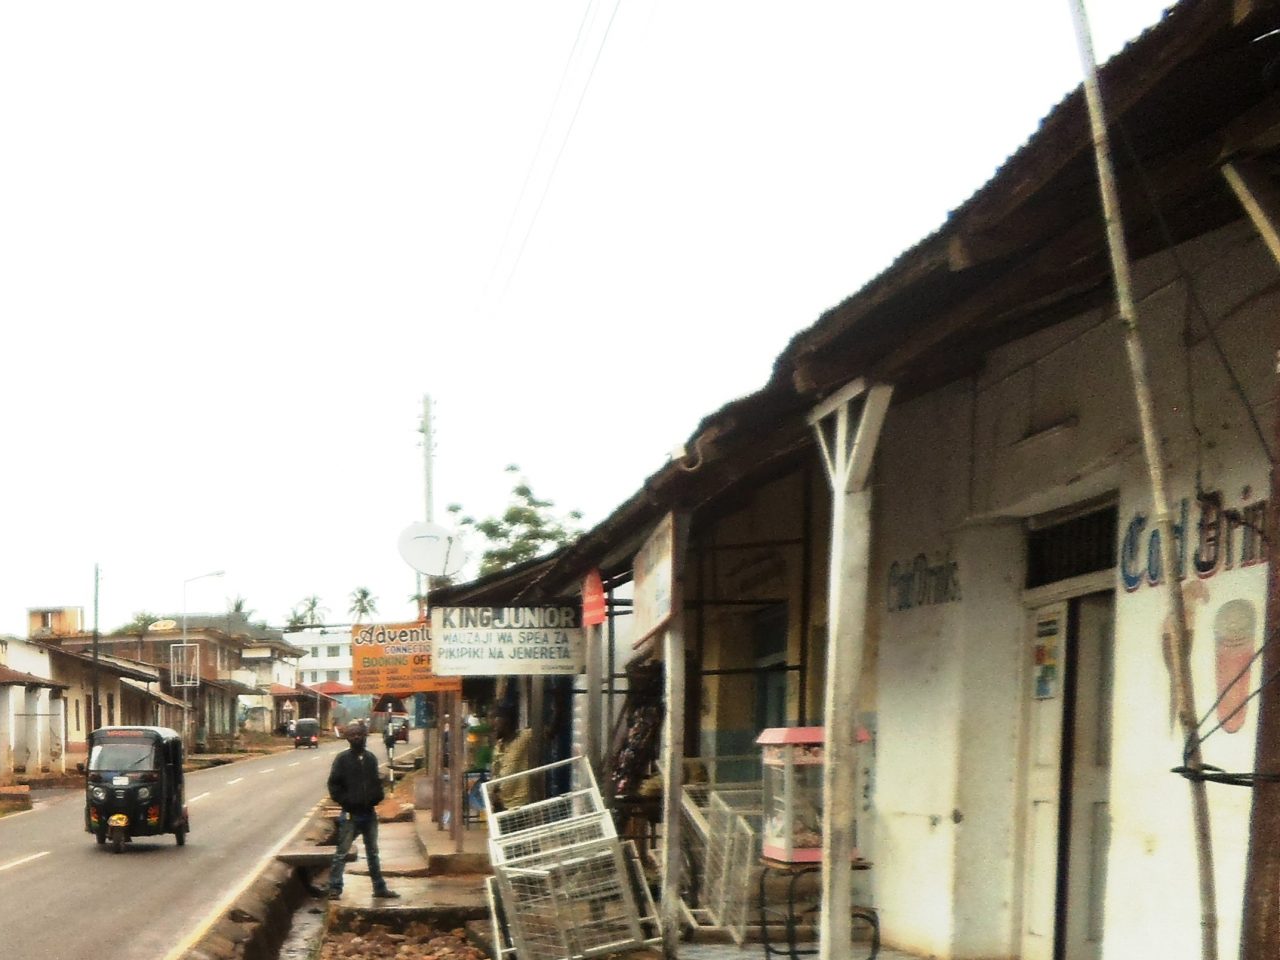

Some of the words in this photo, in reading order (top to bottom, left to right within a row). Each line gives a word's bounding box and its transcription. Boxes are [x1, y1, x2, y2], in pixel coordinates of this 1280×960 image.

[442, 606, 492, 628] KING
[494, 606, 575, 628] JUNIOR
[443, 632, 492, 645] WAUZAJI
[497, 632, 513, 645] WA
[518, 631, 549, 645] SPEA
[554, 631, 569, 645] ZA
[438, 647, 483, 660] PIKIPIKI
[488, 647, 504, 660] NA
[509, 646, 571, 660] JENERETA
[362, 655, 409, 668] BOOKING
